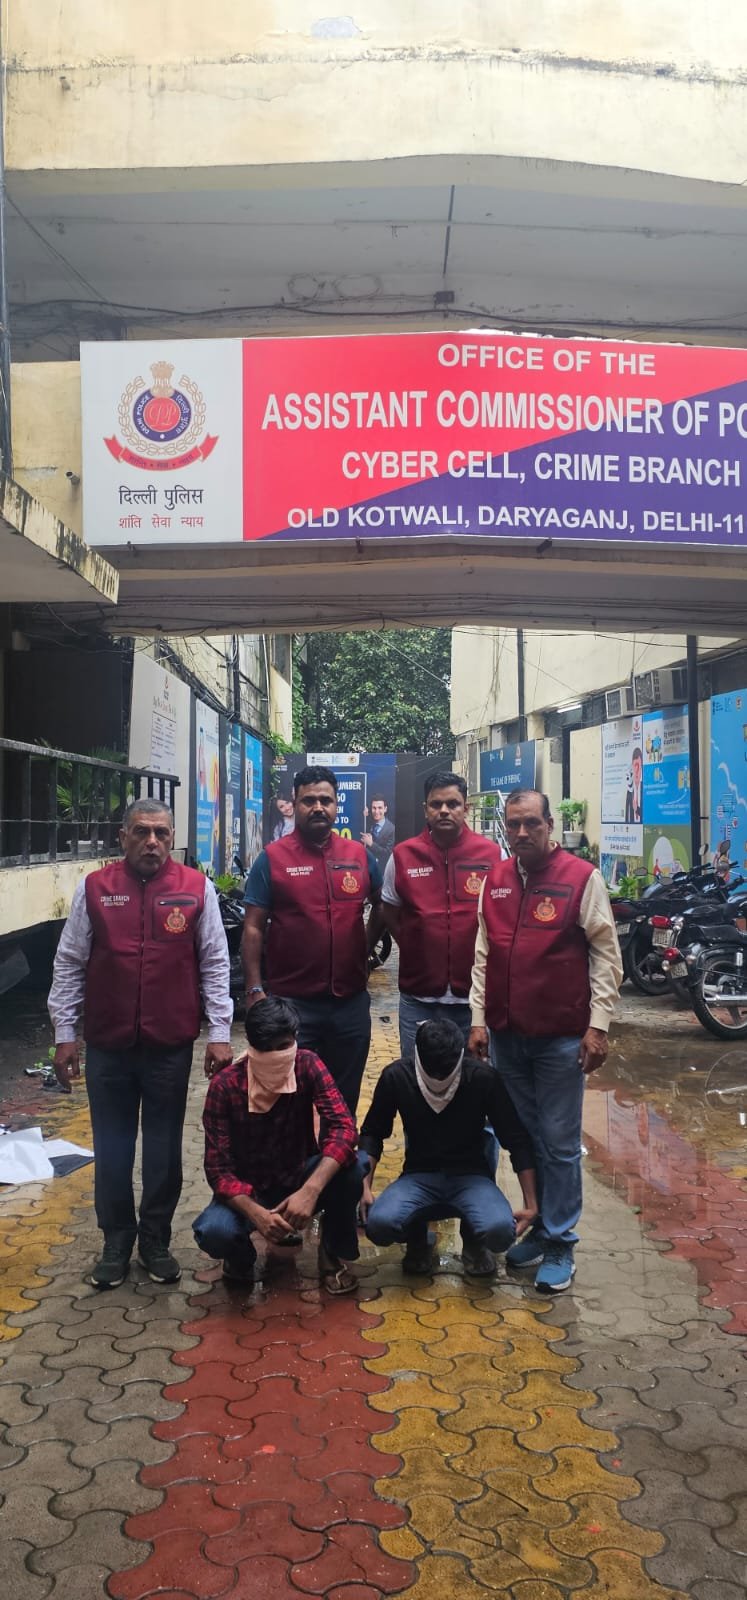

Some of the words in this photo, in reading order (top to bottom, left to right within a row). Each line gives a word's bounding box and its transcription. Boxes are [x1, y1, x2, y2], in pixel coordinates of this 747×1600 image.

[438, 343, 544, 371] OFFICE
[553, 349, 592, 372] OF
[600, 352, 656, 376] THE
[261, 390, 427, 430] ASSISTANT
[436, 390, 665, 434] COMMISSIONER
[672, 400, 710, 436] OF
[342, 450, 439, 480] CYBER
[447, 450, 526, 484] CELL,
[534, 452, 620, 482] CRIME
[629, 456, 741, 487] BRANCH
[118, 484, 158, 505] दिल्ली
[164, 484, 204, 511] पुलिस
[119, 514, 142, 529] शांति
[151, 513, 172, 529] सेवा
[180, 516, 204, 528] न्याय
[287, 507, 340, 529] OLD
[348, 505, 471, 529] KOTWALI,
[478, 505, 635, 534] DARYAGANJ,
[643, 510, 744, 534] DELHI-11
[338, 781, 362, 791] UMBER
[340, 815, 349, 824] TO
